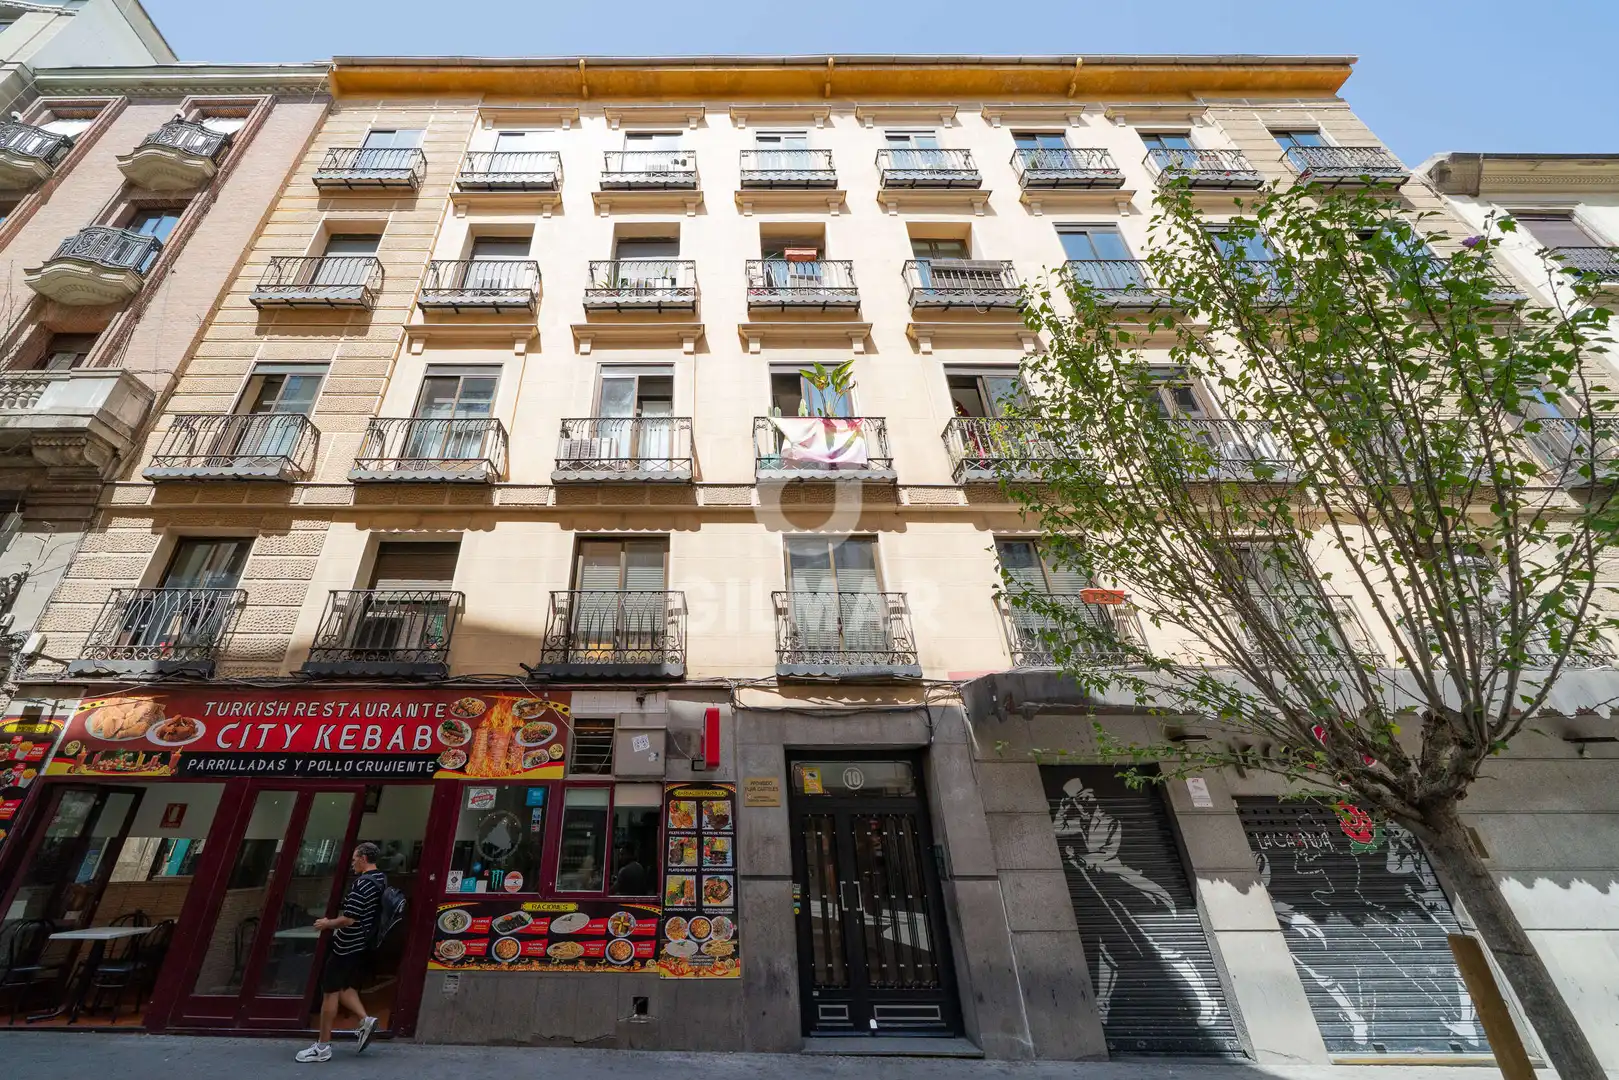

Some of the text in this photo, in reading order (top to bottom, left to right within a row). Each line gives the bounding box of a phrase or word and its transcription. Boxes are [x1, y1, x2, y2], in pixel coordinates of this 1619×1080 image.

[205, 700, 448, 718] TURKISH RESTAURANTE
[216, 720, 433, 751] CITY KEBAB
[186, 758, 436, 773] PARRILLADAS Y POLLO CRUJIENTE
[846, 771, 861, 786] 10
